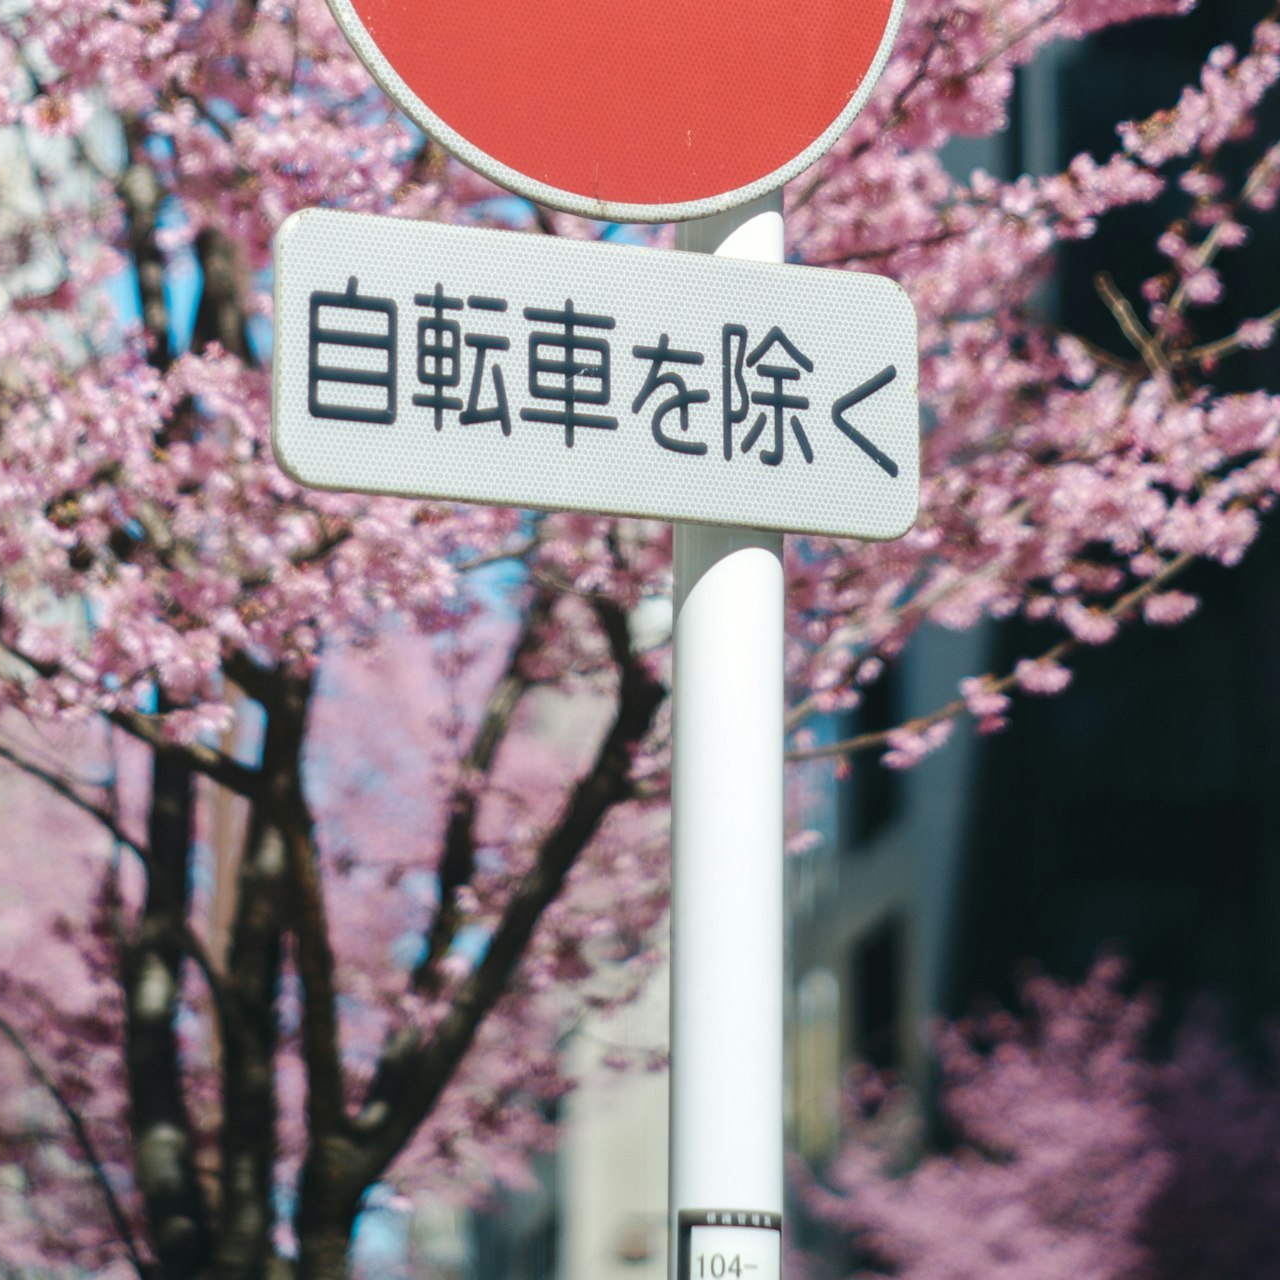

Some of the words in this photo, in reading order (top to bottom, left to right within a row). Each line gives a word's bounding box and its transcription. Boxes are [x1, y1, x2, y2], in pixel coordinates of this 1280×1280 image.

[307, 275, 899, 478] 自転車を除く
